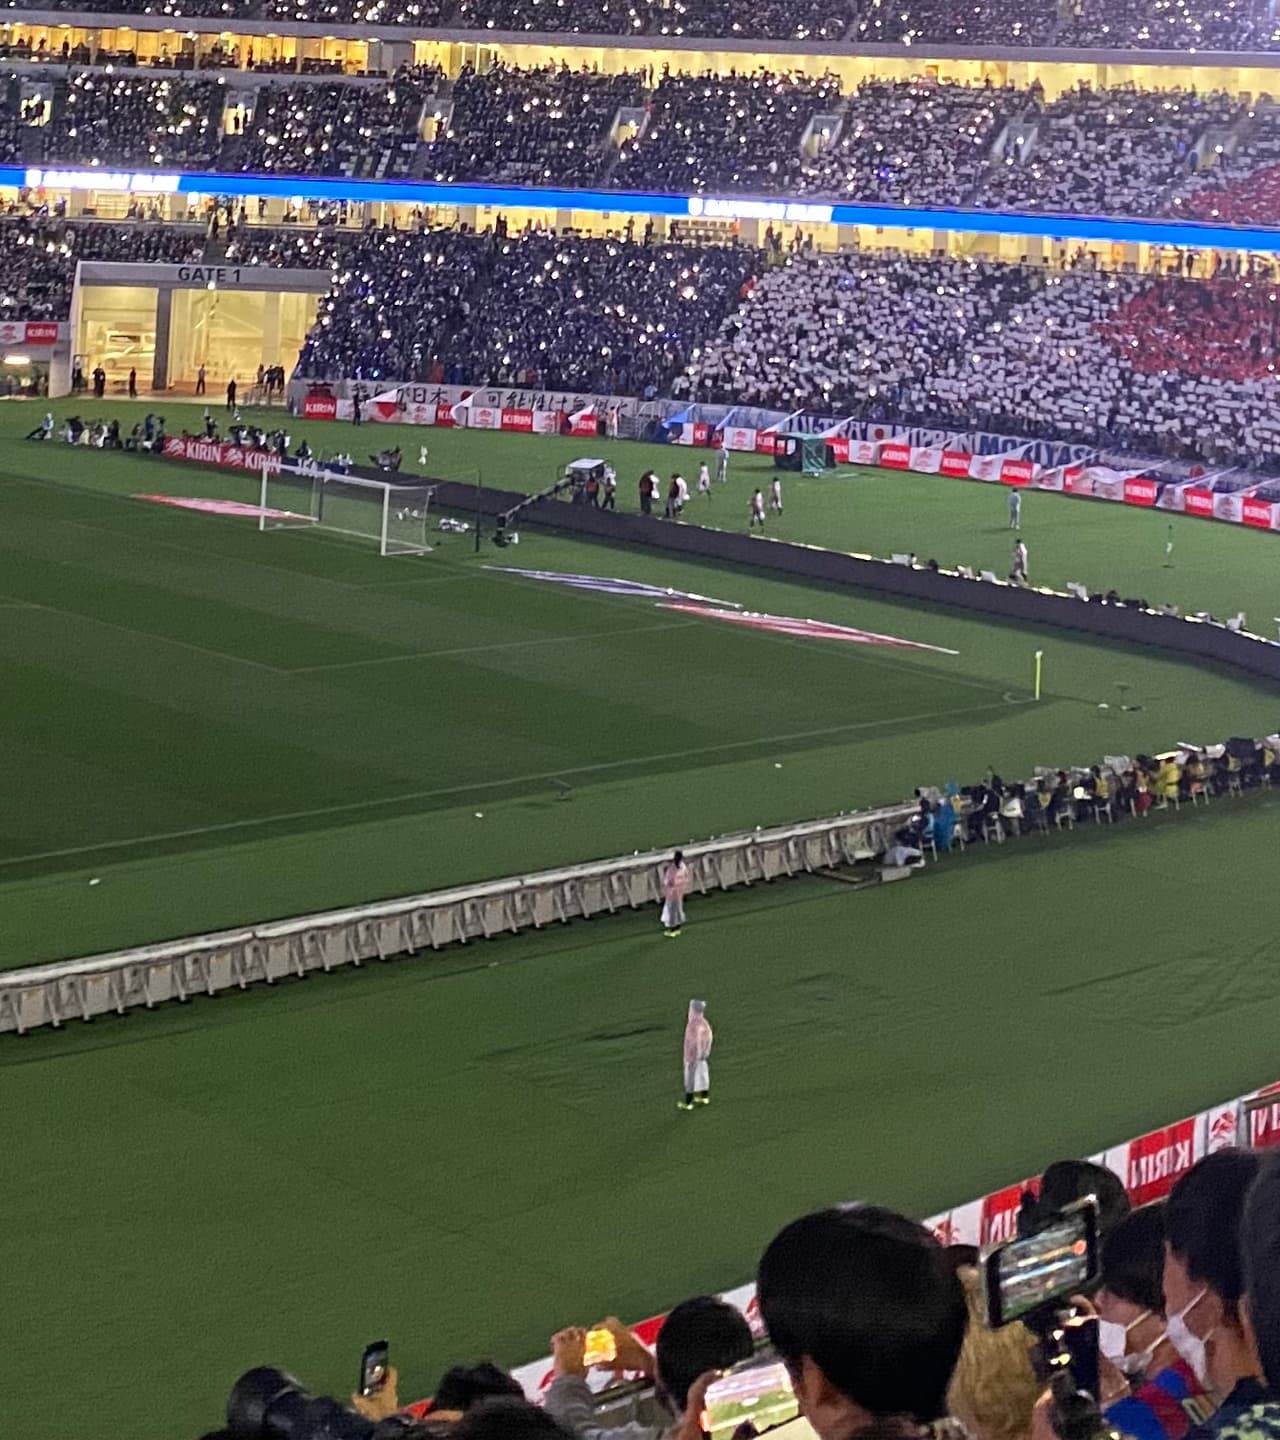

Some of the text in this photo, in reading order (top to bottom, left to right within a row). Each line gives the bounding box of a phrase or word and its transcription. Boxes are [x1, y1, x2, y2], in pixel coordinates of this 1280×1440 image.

[178, 266, 241, 283] GATE 1
[27, 328, 57, 338] KIRIN
[305, 402, 335, 414] KIRIN
[502, 413, 532, 424] KIRIN
[186, 441, 221, 463] KIRIN
[244, 451, 282, 473] KIRIN
